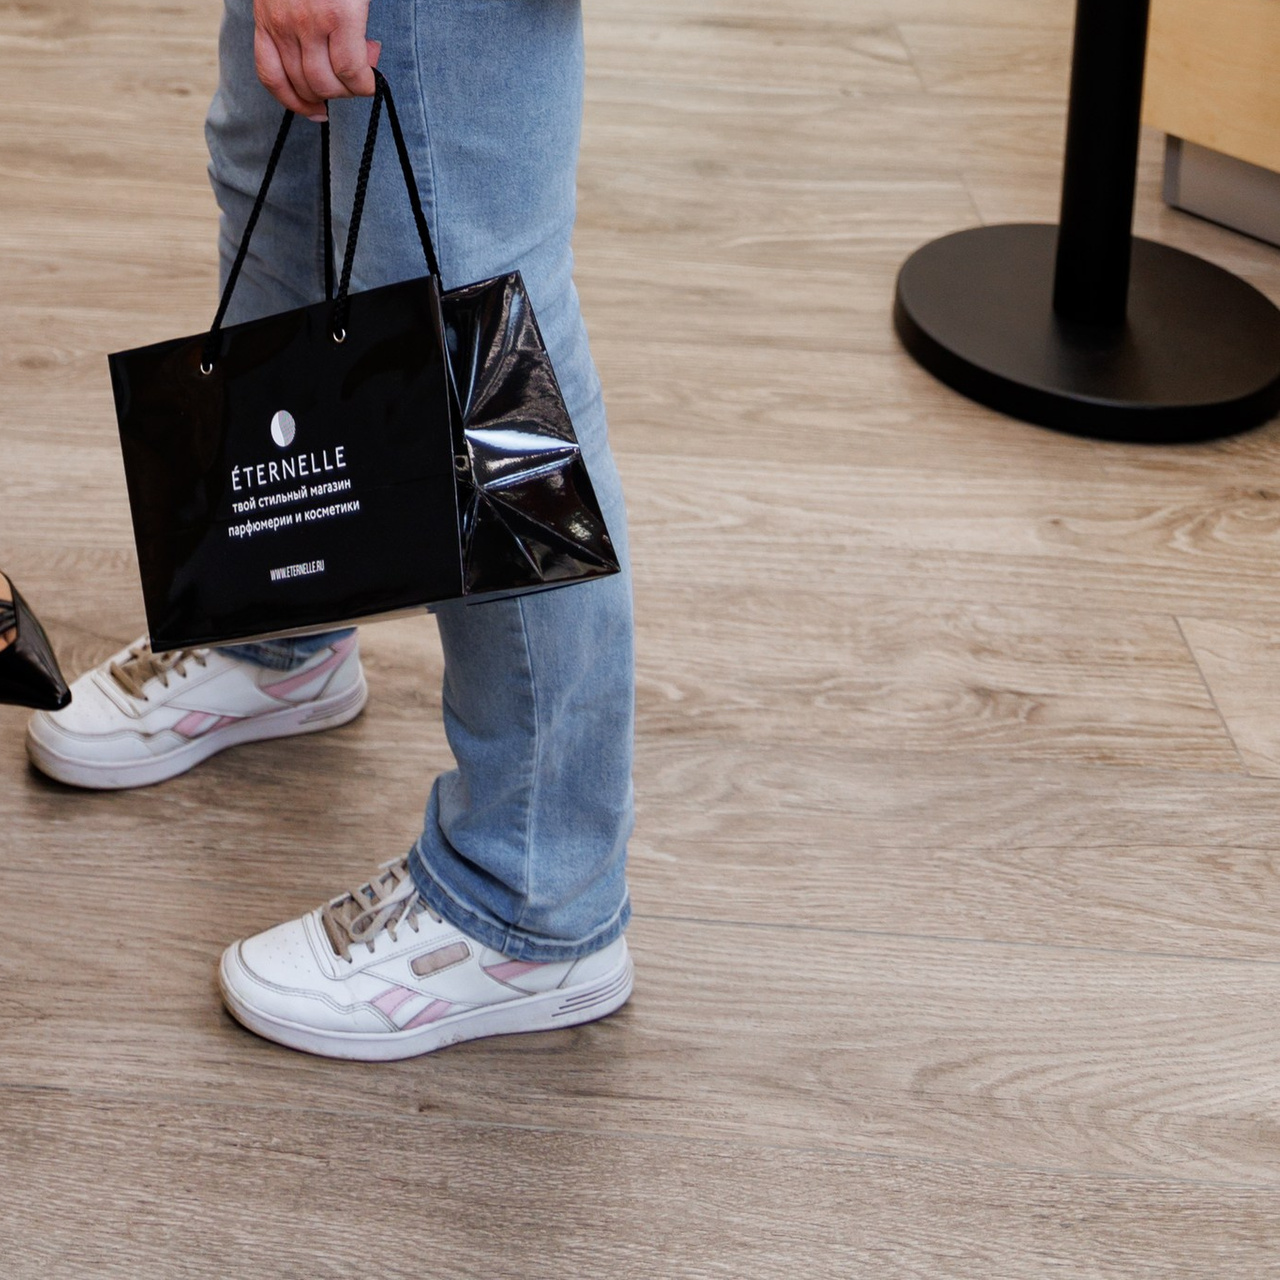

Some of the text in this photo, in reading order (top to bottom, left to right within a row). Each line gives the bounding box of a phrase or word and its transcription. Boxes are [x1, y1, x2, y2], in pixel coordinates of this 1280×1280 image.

[231, 446, 347, 491] ÉTERNELLE
[232, 479, 352, 513] твой стильный магазин
[228, 500, 360, 538] парфюмерии и косметики
[270, 559, 325, 581] WWW.ETERNELLE.RU
